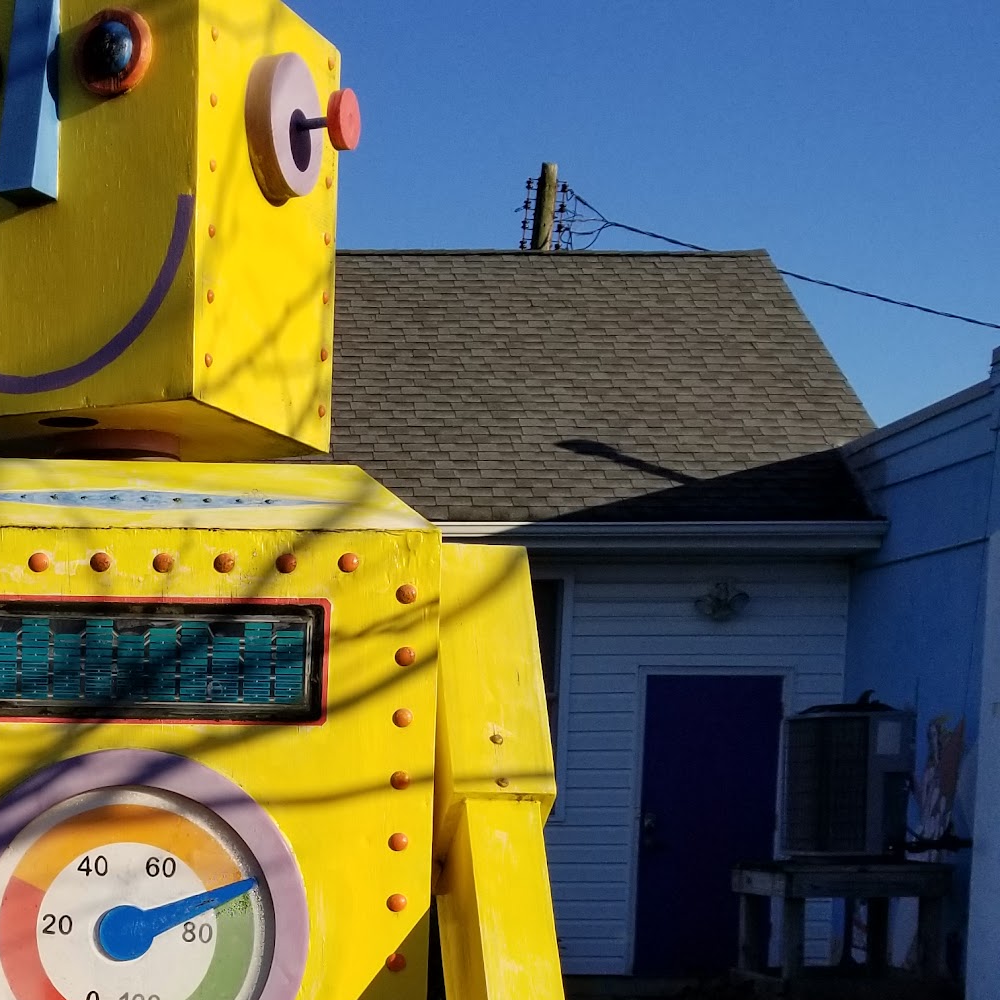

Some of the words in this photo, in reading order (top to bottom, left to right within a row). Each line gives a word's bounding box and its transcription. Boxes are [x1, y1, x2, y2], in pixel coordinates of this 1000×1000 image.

[77, 855, 108, 877] 40
[145, 856, 176, 878] 60
[42, 913, 73, 935] 20
[181, 921, 213, 944] 80
